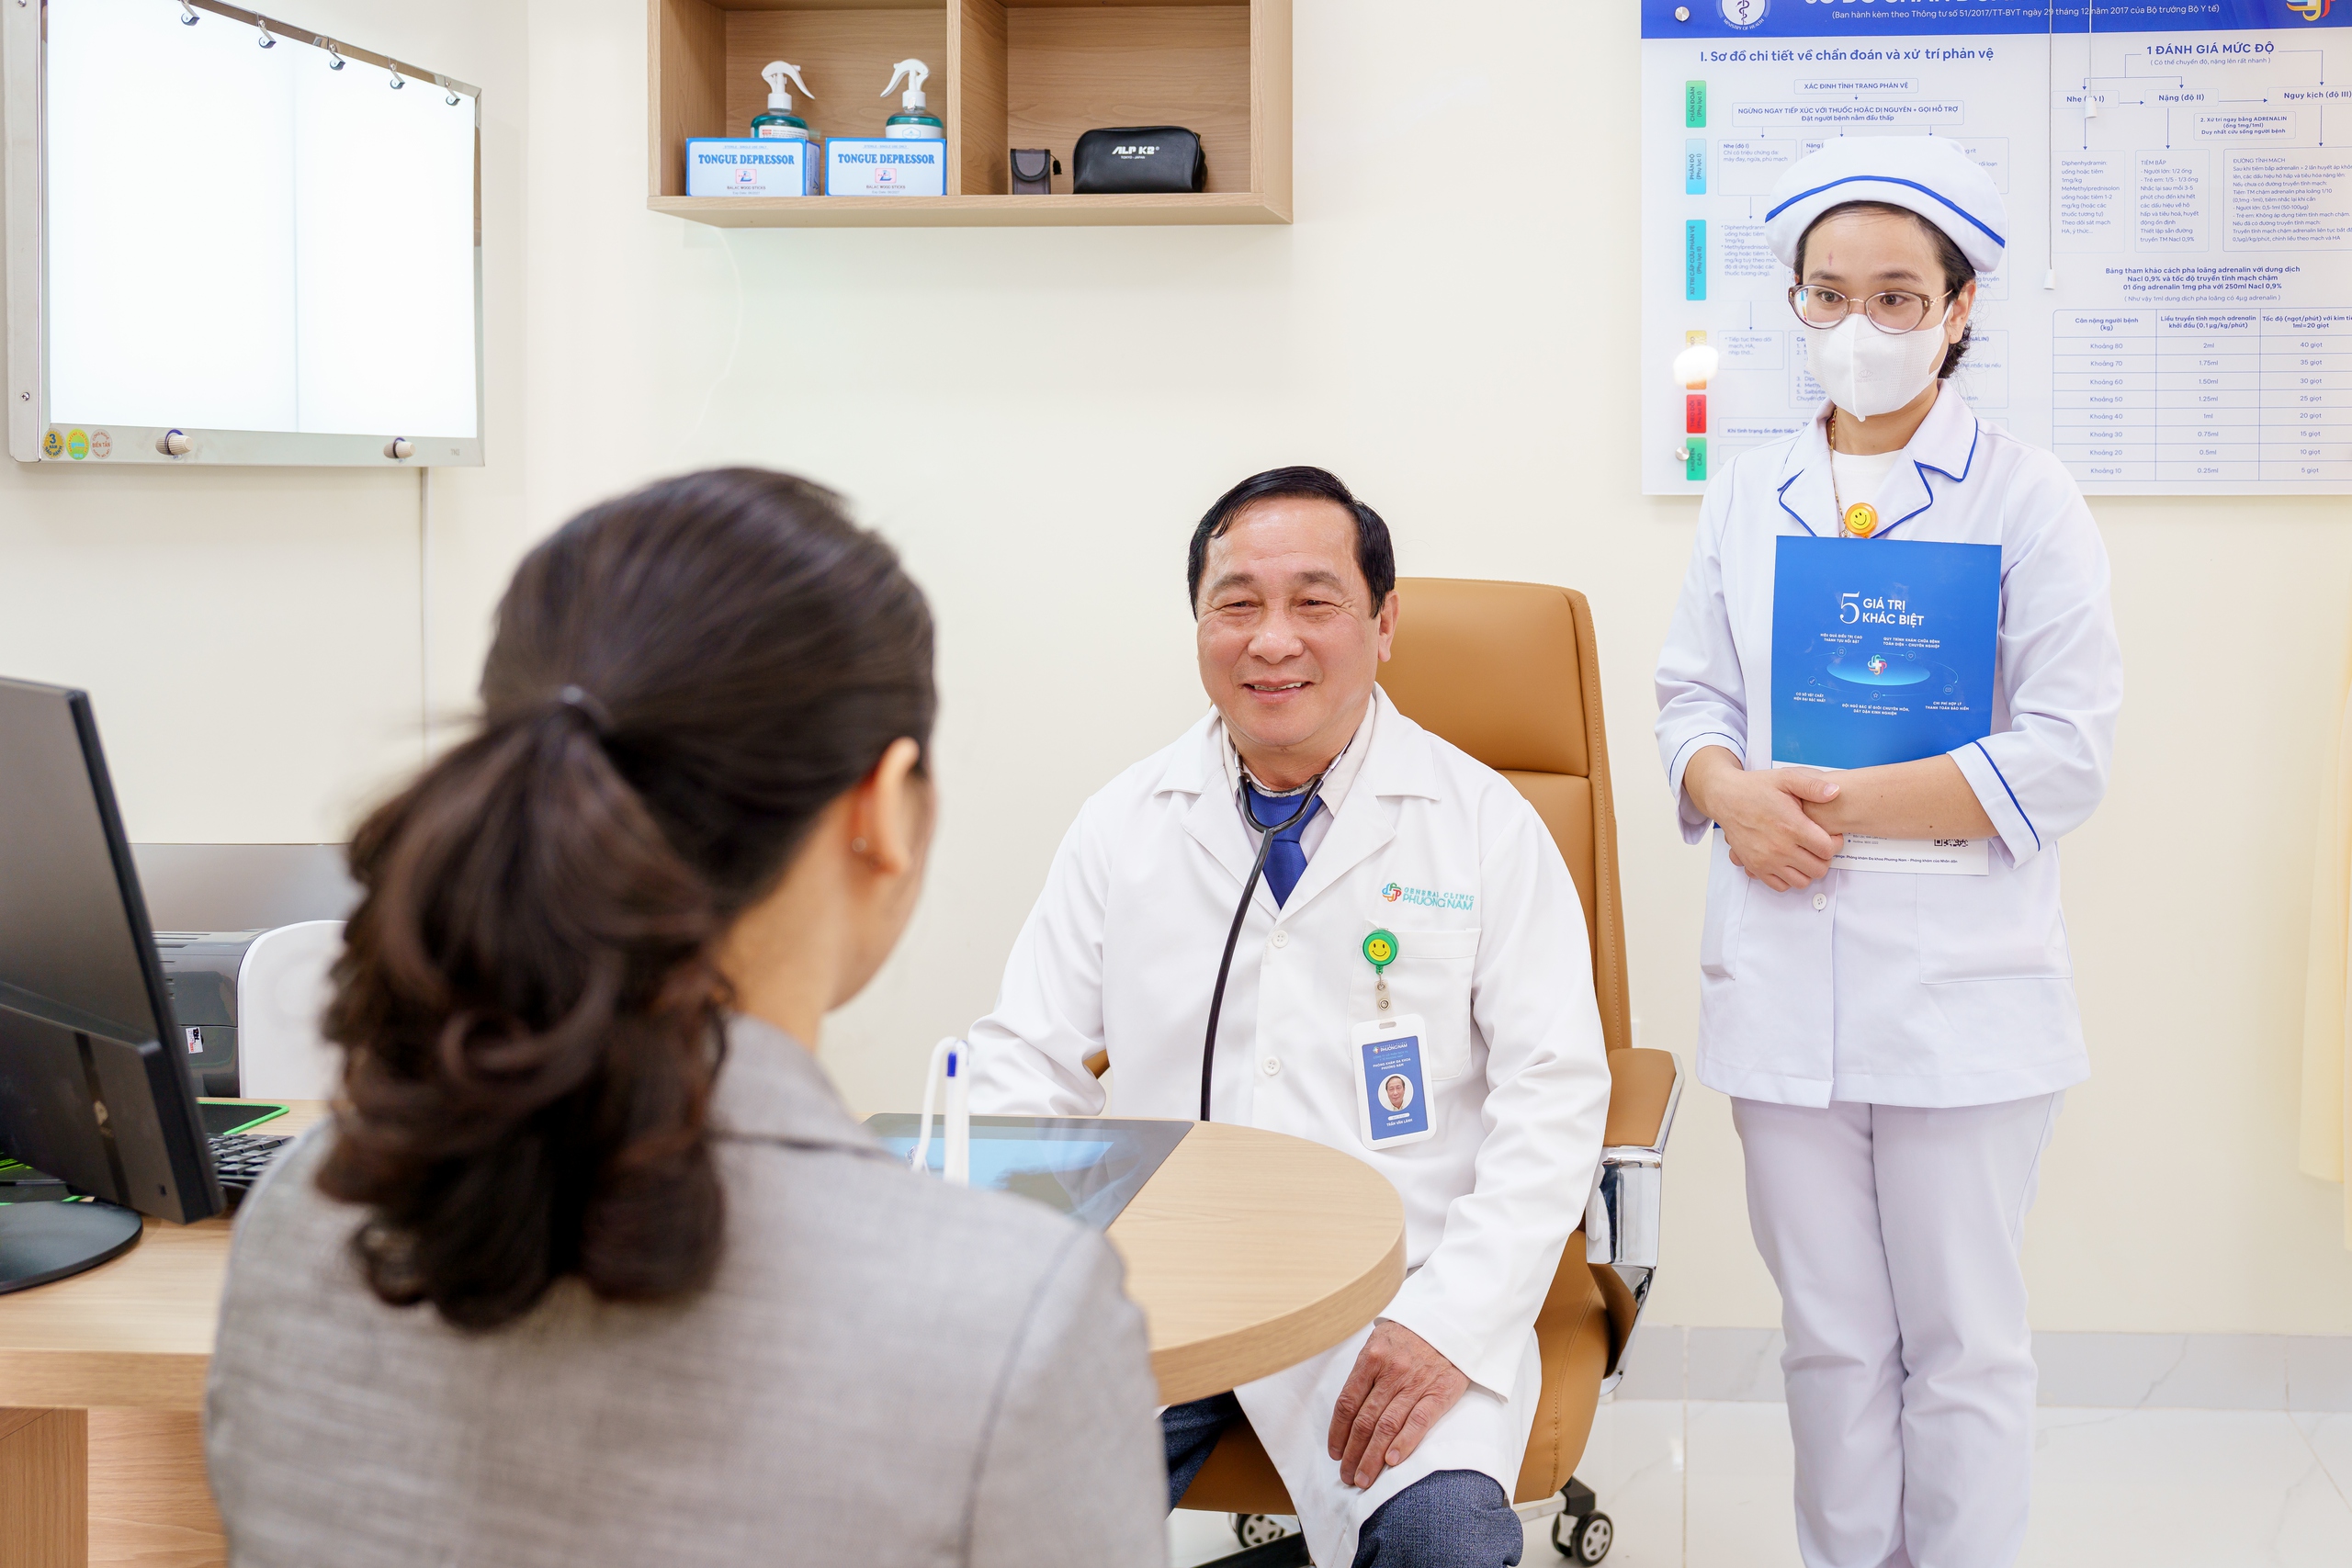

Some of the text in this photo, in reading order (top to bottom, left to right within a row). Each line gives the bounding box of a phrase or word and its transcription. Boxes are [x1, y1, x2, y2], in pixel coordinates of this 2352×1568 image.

[1832, 10, 1850, 19] (Ban
[1911, 10, 1937, 19] Thông
[1948, 9, 1958, 17] số
[1959, 9, 2021, 17] 51/2017/TT-BYT
[2023, 8, 2042, 18] ngày
[2055, 8, 2079, 16] tháng
[2130, 6, 2145, 14] của
[2147, 6, 2157, 14] Bộ
[2159, 5, 2186, 15] trưởng
[2188, 5, 2199, 13] Bộ
[2208, 4, 2220, 13] tế)
[2147, 41, 2274, 55] 1 ĐÁNH GIÁ MỨC ĐỘ
[1711, 51, 1728, 62] Sơ
[1729, 50, 1746, 61] đồ
[1749, 50, 1768, 61] chi
[1771, 49, 1794, 61] tiết
[1797, 49, 1813, 61] về
[1816, 48, 1847, 60] chẩn
[1850, 49, 1882, 60] đoán
[1886, 49, 1900, 60] và
[1904, 48, 1921, 59] xử
[1925, 48, 1940, 59] trí
[1943, 47, 1975, 61] phản
[1978, 47, 1994, 61] vệ
[2159, 94, 2179, 103] Nặng
[2181, 94, 2194, 102] (độ
[2284, 92, 2305, 100] Nguy
[2307, 91, 2324, 99] kịch
[1112, 146, 1136, 155] ALP
[698, 154, 795, 165] TONGUE DEPRESSOR
[838, 154, 935, 164] TONGUE DEPRESSOR
[49, 433, 56, 444] 3
[1840, 591, 1860, 624] 5
[1863, 596, 1906, 613] GIÁ TRỊ
[1862, 611, 1925, 628] KHÁC BIỆT
[1443, 892, 1474, 901] CLINIC
